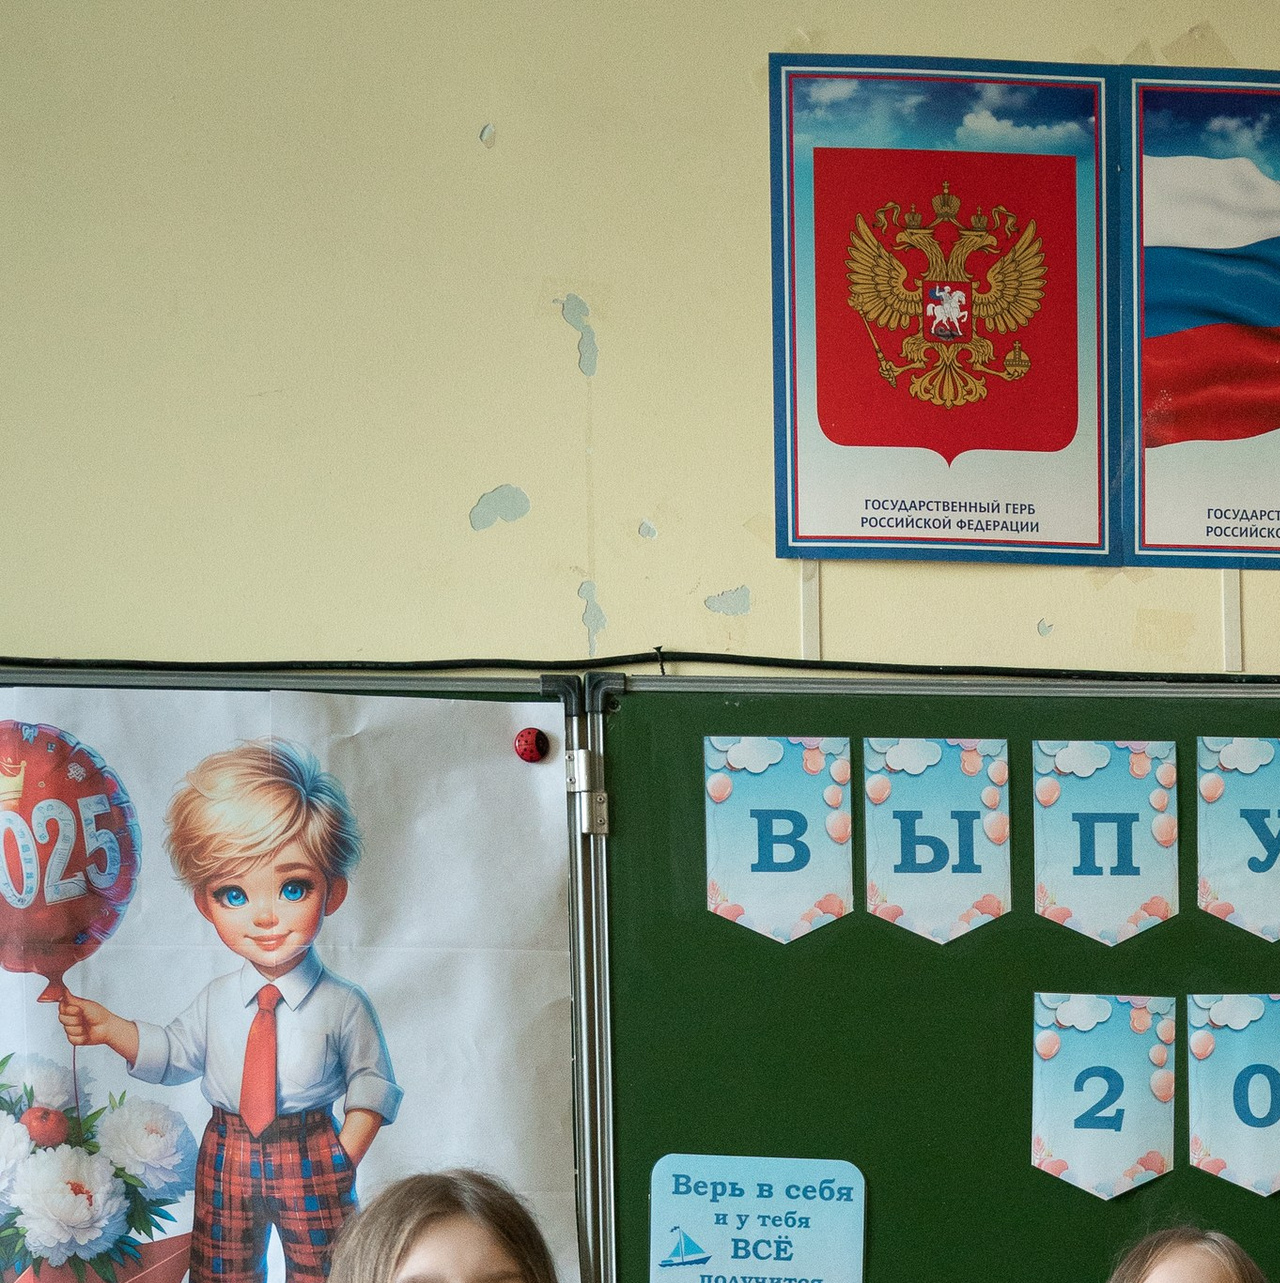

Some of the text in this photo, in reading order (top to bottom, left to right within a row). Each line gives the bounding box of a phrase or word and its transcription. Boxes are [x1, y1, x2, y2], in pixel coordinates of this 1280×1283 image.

[864, 499, 1036, 514] ГОСУДАРСТВЕННЫЙ ГЕРБ
[861, 515, 1039, 533] РОССИЙСКОЙ ФЕДЕРАЦИИ
[672, 1173, 853, 1203] Верь в себя
[715, 1211, 810, 1230] и у тебя
[731, 1236, 794, 1261] ВСЁ
